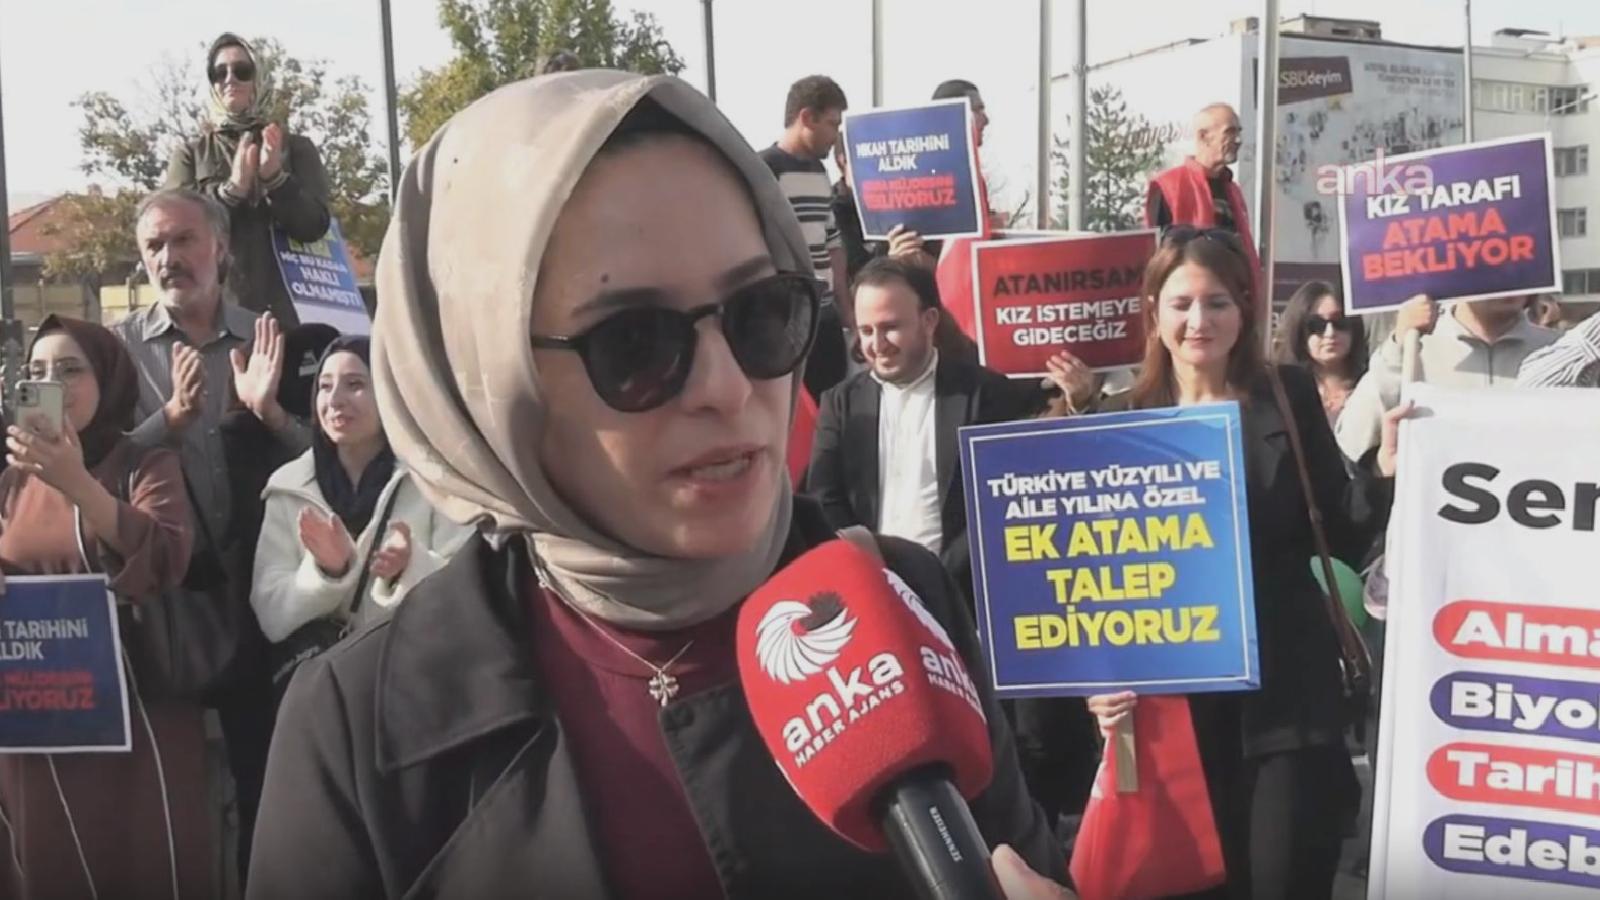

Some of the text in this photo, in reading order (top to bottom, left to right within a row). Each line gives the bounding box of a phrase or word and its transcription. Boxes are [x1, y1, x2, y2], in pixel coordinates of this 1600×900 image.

[878, 154, 917, 172] ALDIK
[1367, 174, 1521, 219] KIZ TARAFI
[1383, 207, 1506, 249] ATAMA
[300, 266, 340, 286] HAKLI
[1363, 235, 1535, 281] BEKLİYOR
[996, 297, 1141, 325] KIZ İSTEMEYE
[1013, 319, 1127, 346] GİDECEĞİZ
[987, 460, 1221, 498] TÜRKİYE YÜZYILI VE
[1005, 485, 1206, 519] AİLE YILINA ÖZEL
[1004, 512, 1214, 561] EK ATAMA
[1046, 561, 1176, 603] TALEP
[4, 618, 88, 639] TARİHİNİ
[1014, 605, 1221, 649] EDİYORUZ
[0, 641, 44, 660] LDIK
[782, 653, 904, 752] anka
[1451, 681, 1600, 730] Biyo
[794, 723, 846, 768] HABER
[1447, 750, 1600, 800] Tarih
